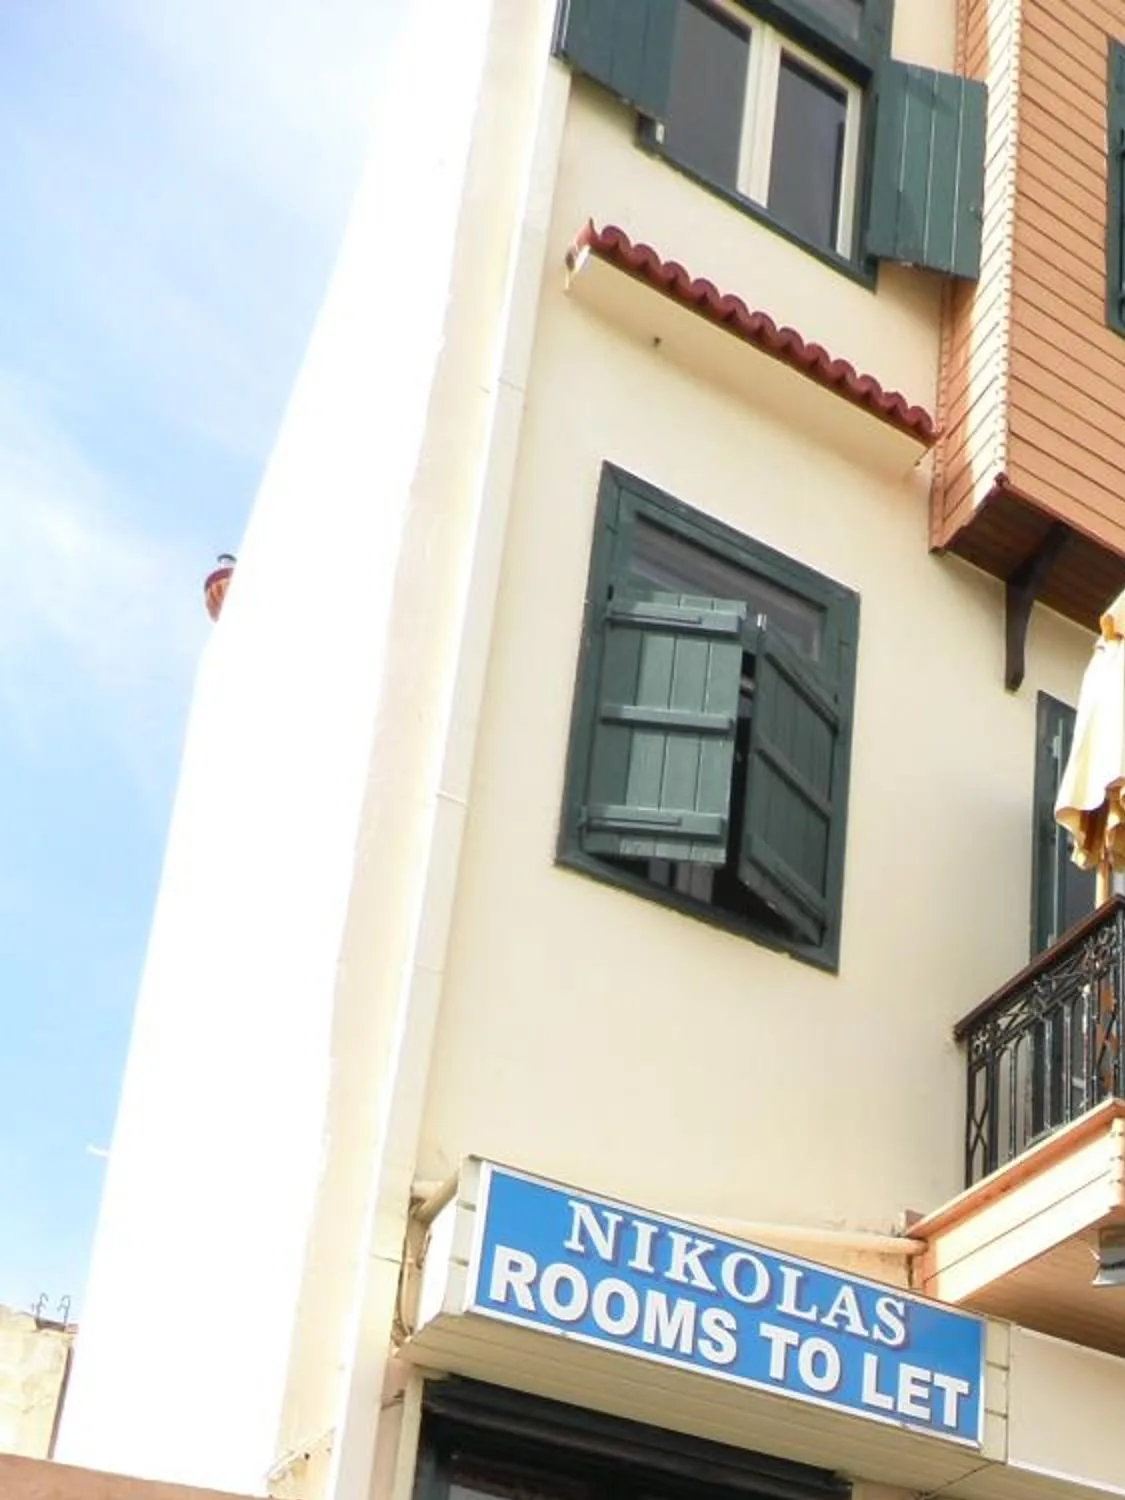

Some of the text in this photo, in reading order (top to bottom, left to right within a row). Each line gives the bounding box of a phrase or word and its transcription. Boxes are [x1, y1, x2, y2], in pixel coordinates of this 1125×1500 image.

[487, 1244, 969, 1429] ROOMS TO LET
[563, 1200, 909, 1347] NIKOLAS
